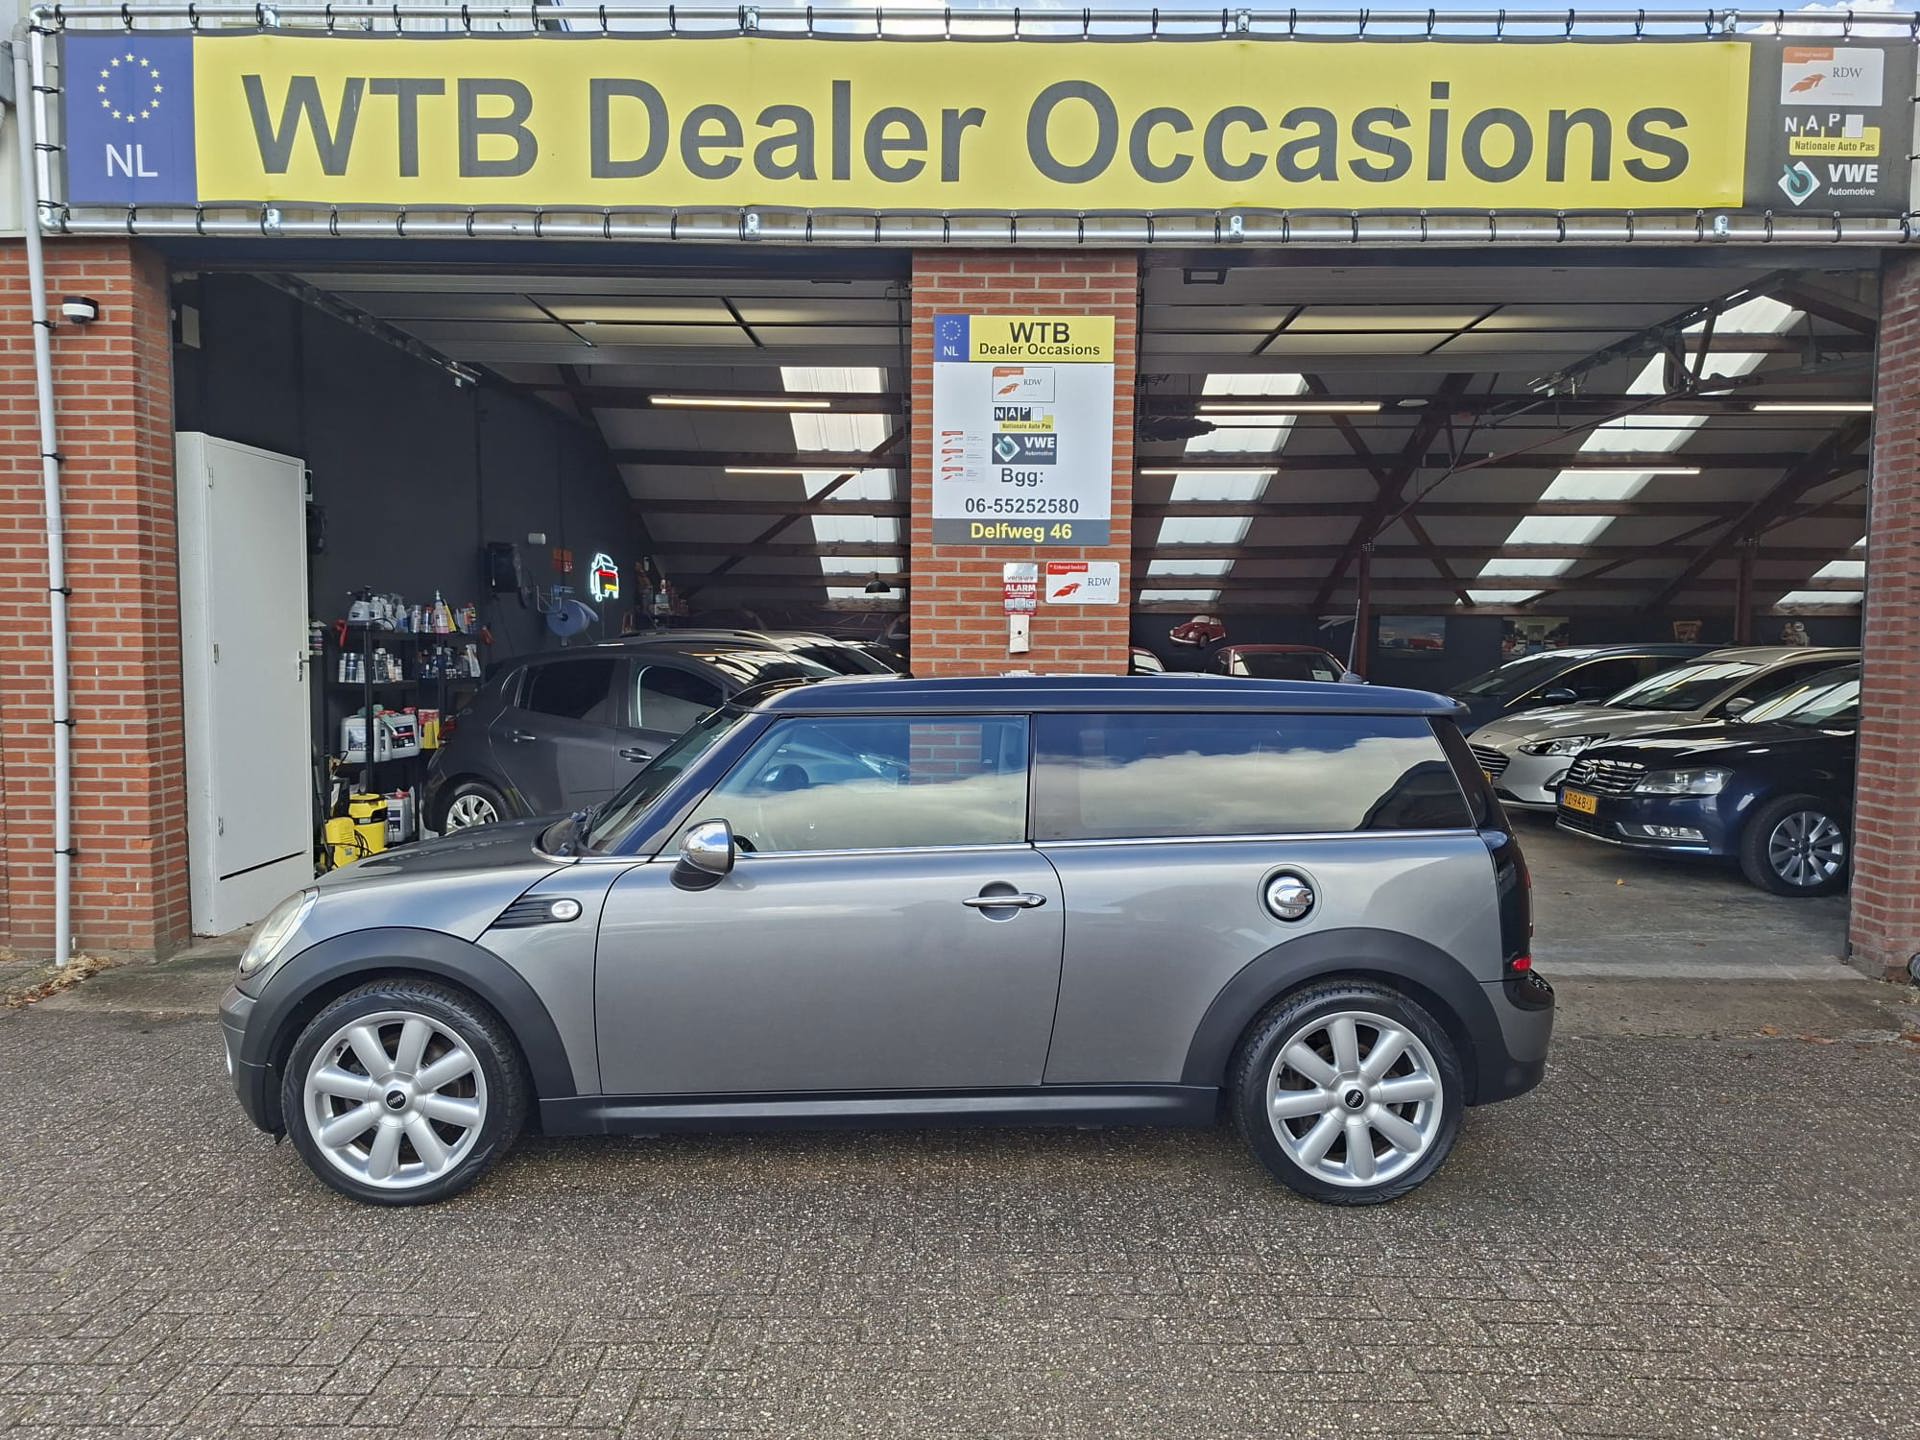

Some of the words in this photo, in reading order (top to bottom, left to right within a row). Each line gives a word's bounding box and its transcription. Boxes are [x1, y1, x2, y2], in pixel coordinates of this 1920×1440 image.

[1832, 66, 1863, 78] RDW
[241, 73, 539, 178] WTB
[589, 78, 987, 183] Dealer
[1026, 79, 1690, 185] Occasions
[1795, 140, 1836, 151] Nationale
[1837, 141, 1858, 152] Auto
[1859, 141, 1876, 152] Pas
[105, 143, 158, 178] NL
[1828, 164, 1879, 183] VWE
[1827, 186, 1876, 197] Automotive
[1009, 322, 1071, 344] WTB
[943, 345, 960, 357] NL
[979, 343, 1023, 356] Dealer
[1027, 343, 1101, 356] Occasions
[1024, 436, 1056, 449] VWE
[1000, 468, 1045, 487] Bgg:
[965, 498, 1079, 514] 06-55252580
[970, 522, 1046, 543] Delfweg
[1050, 522, 1073, 540] 46
[1005, 584, 1036, 592] ALARM
[1087, 577, 1112, 587] RDW
